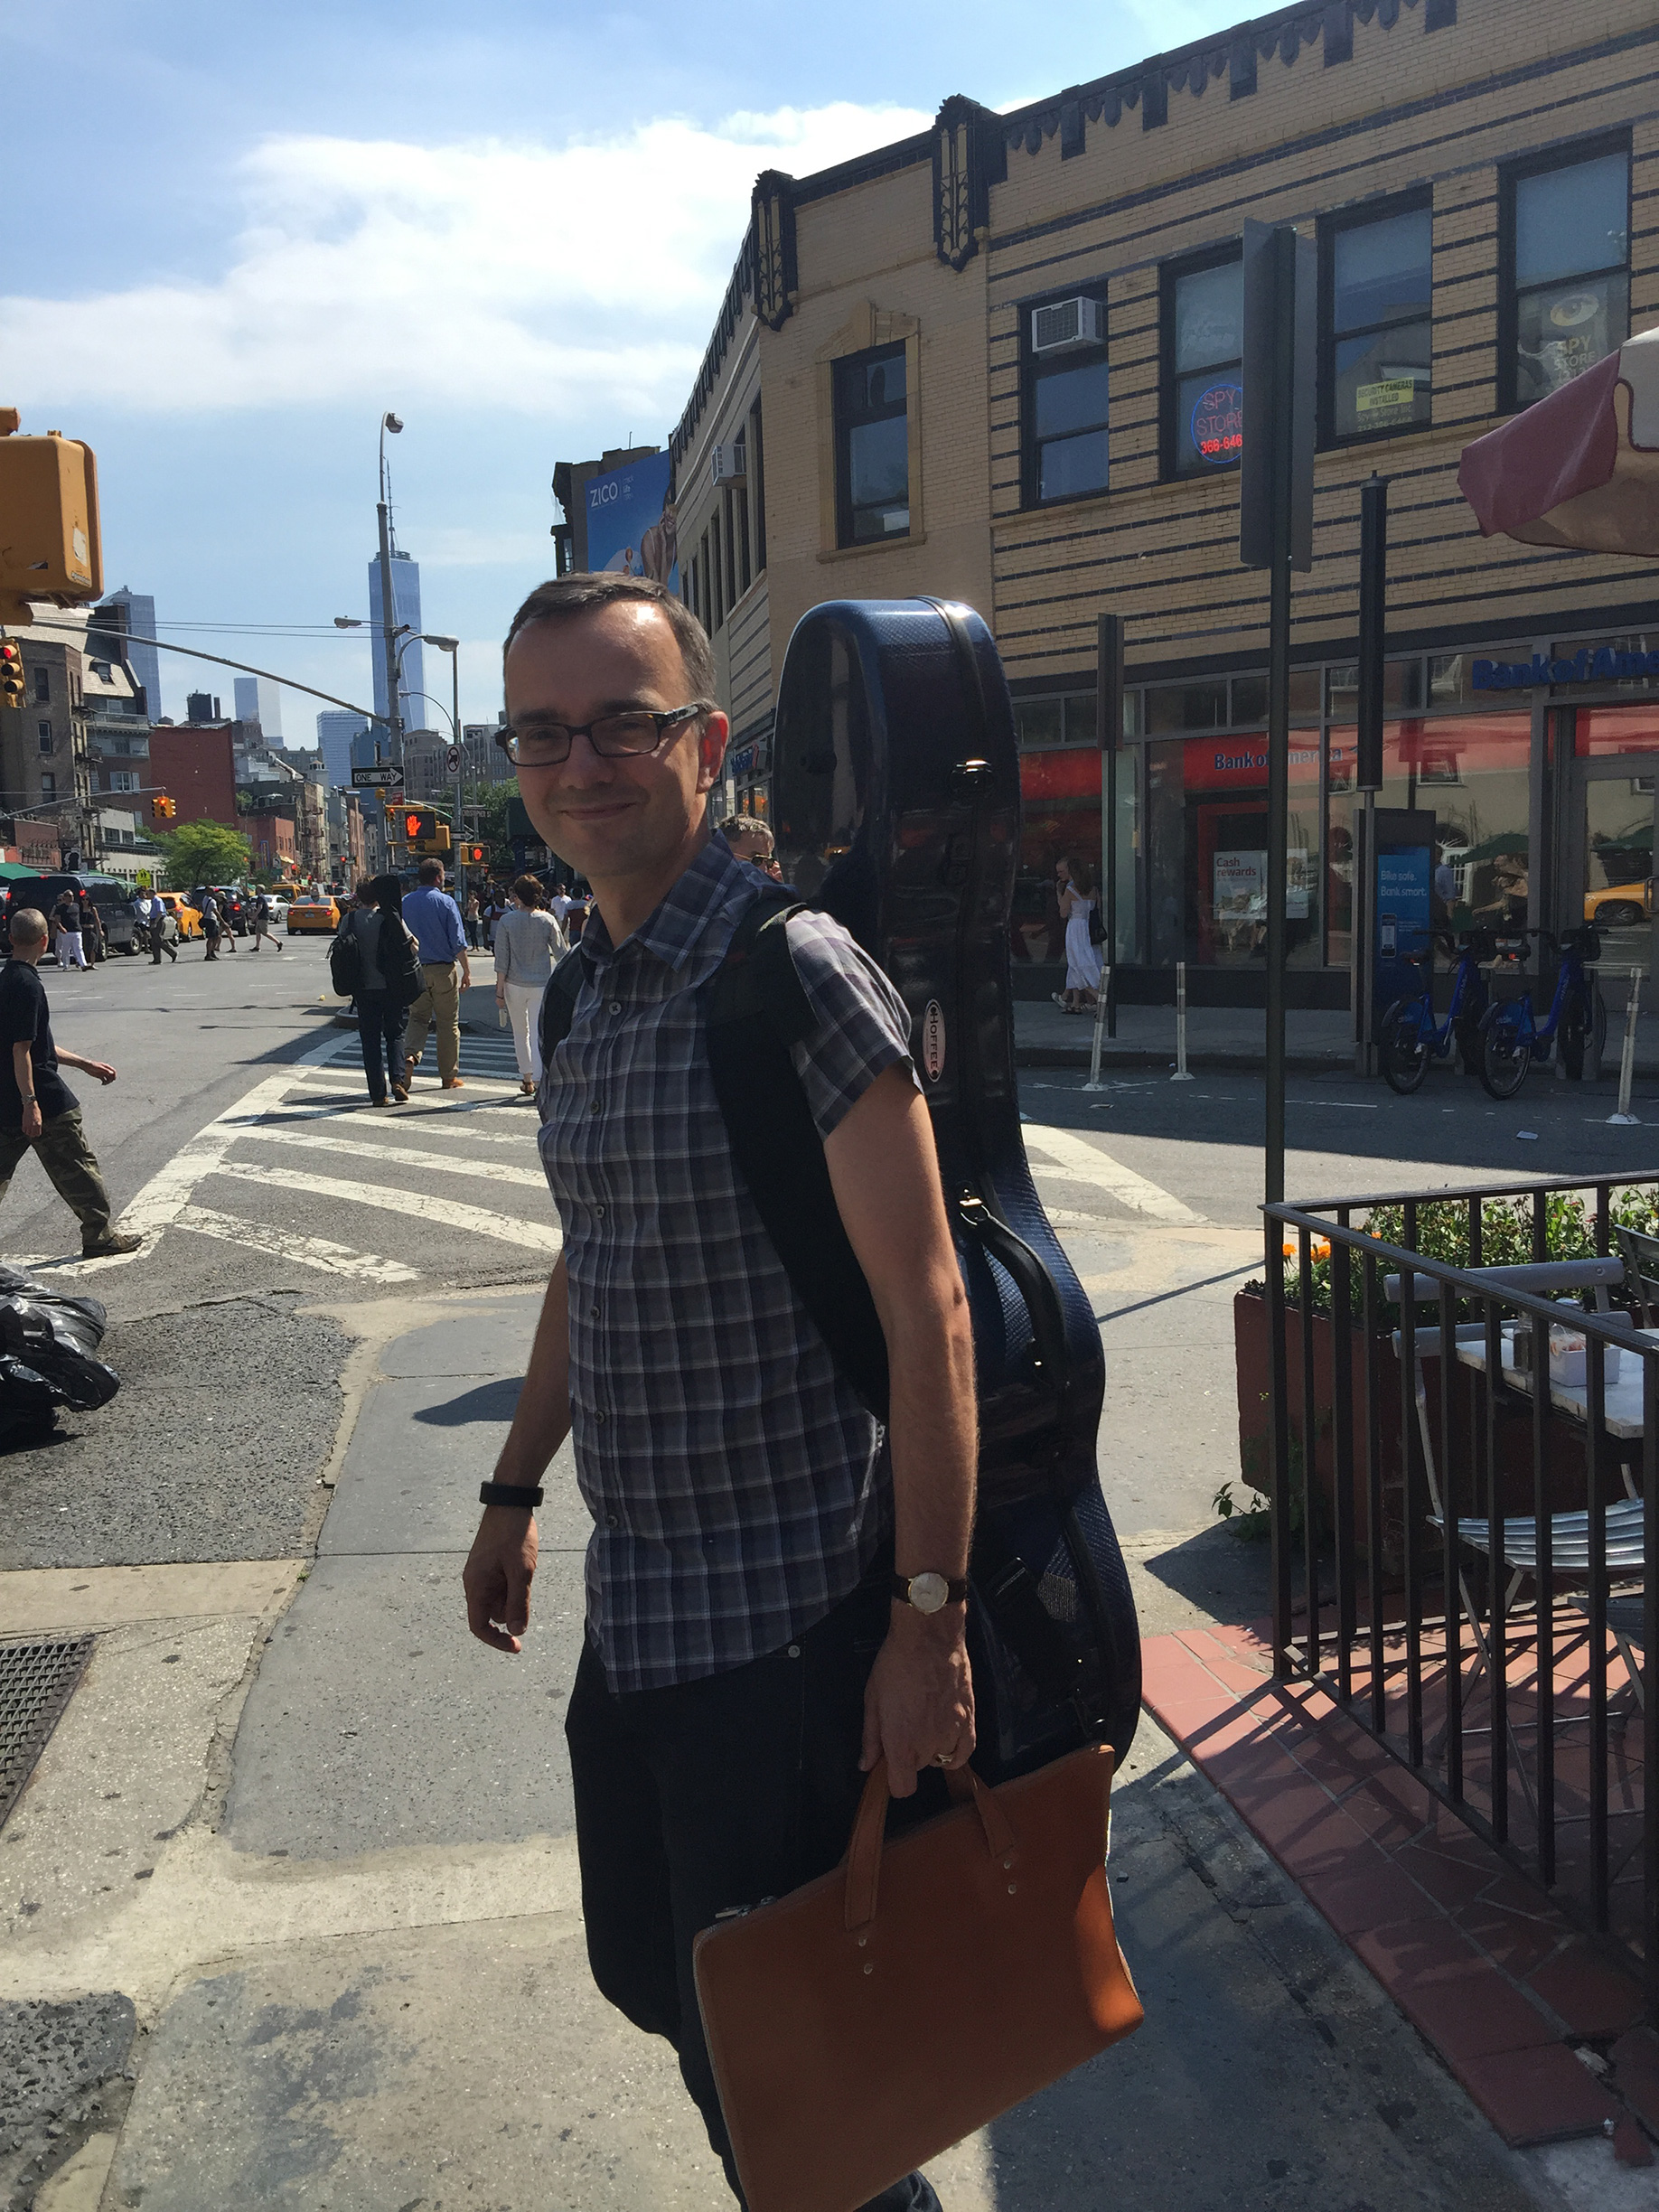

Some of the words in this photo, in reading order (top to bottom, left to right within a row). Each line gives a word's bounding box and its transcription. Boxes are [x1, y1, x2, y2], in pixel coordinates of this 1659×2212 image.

[1554, 351, 1596, 370] STORE
[1385, 380, 1412, 392] CAMERAS
[1203, 389, 1236, 411] SPY
[1369, 392, 1400, 406] INSTALLED
[1196, 409, 1242, 436] STORE
[590, 482, 618, 507] ZICO
[1472, 653, 1552, 689] Bank
[1552, 648, 1592, 682] of
[1214, 751, 1253, 770] Bank
[356, 773, 371, 782] ONE
[380, 773, 397, 781] WAY
[1216, 857, 1241, 867] Cash
[1216, 867, 1257, 876] rewards
[1381, 870, 1397, 881] Bike
[1381, 886, 1401, 896] Bank
[930, 1013, 939, 1069] HOFFEE
